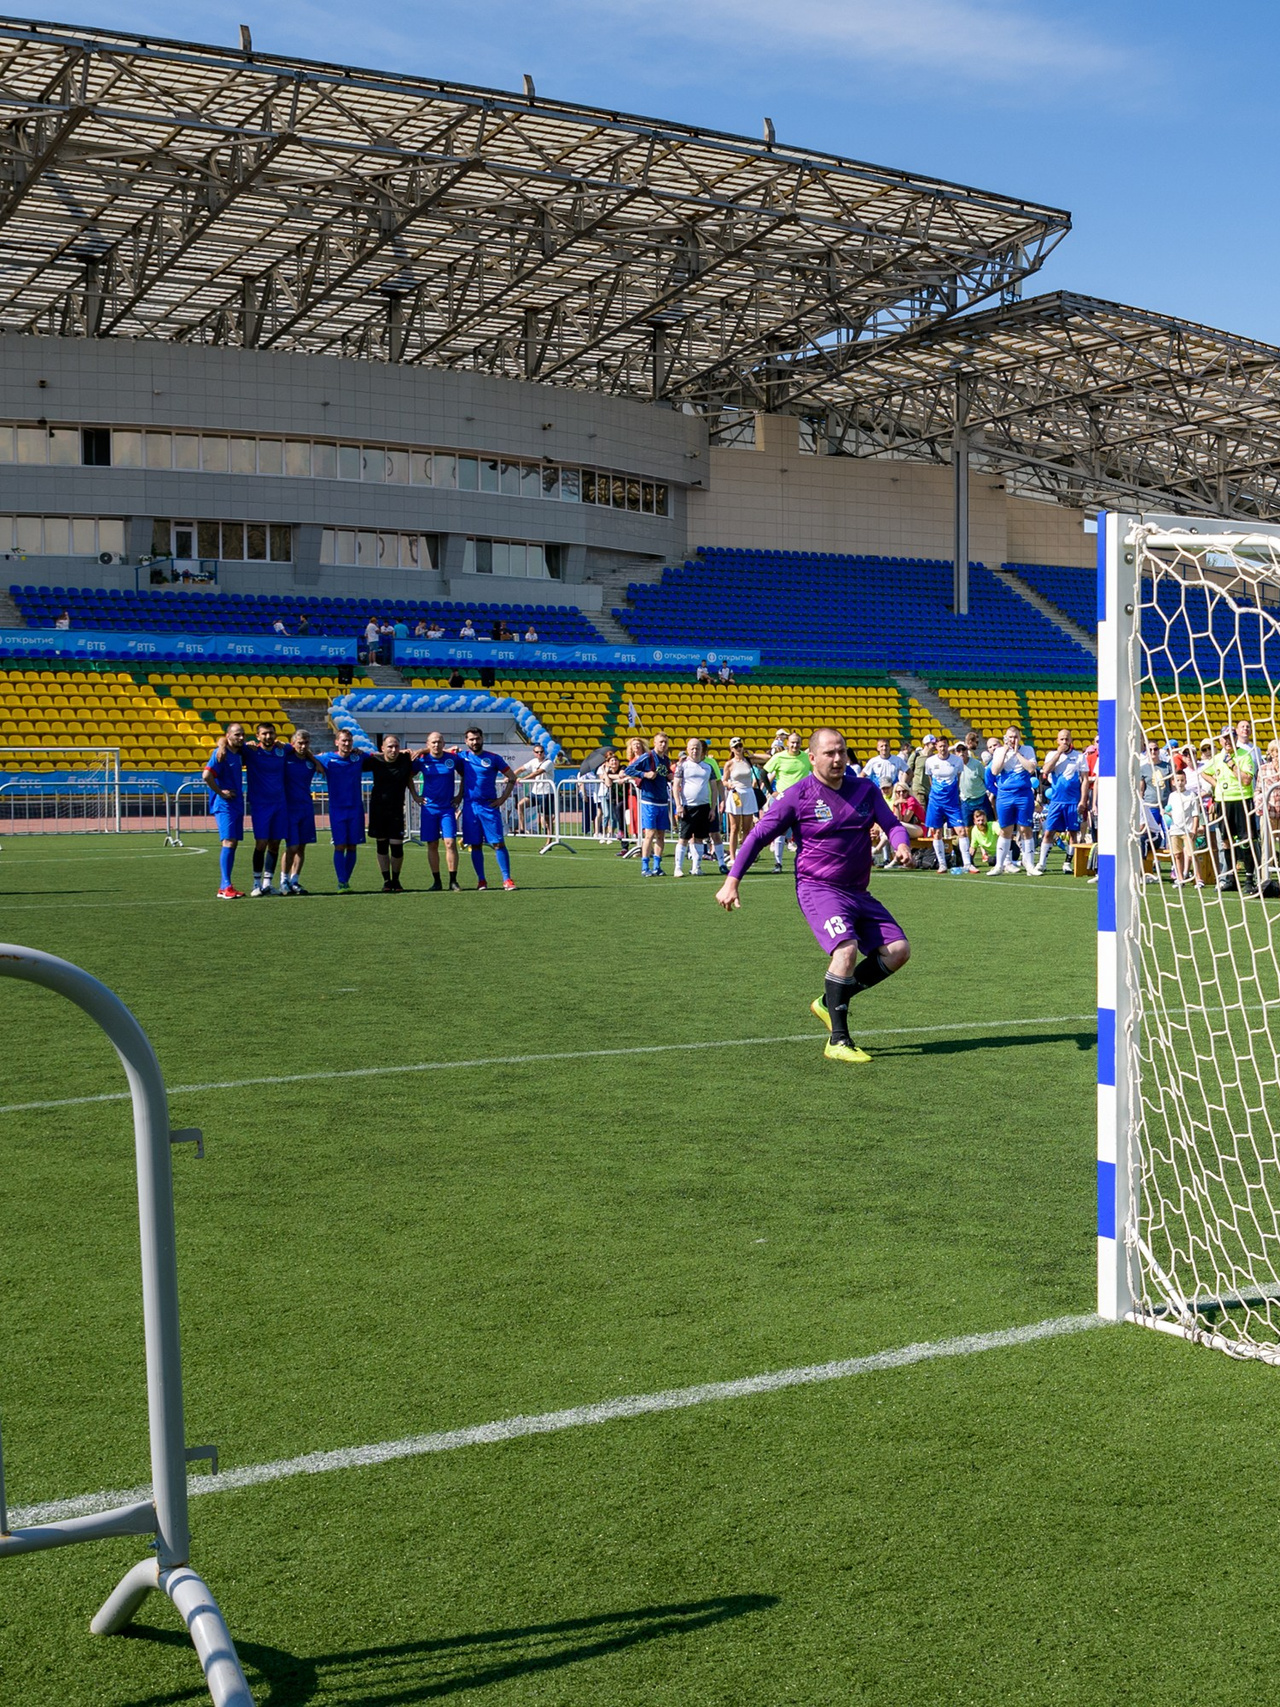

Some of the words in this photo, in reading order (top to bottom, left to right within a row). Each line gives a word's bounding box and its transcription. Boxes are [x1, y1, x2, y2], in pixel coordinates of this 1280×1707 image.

[87, 641, 106, 650] ВТБ
[137, 642, 156, 651] ВТБ
[185, 644, 203, 653] ВТБ
[236, 645, 254, 653] ВТБ
[283, 646, 300, 655] ВТБ
[328, 647, 346, 655] ВТБ
[413, 649, 430, 657] ВТБ
[456, 650, 473, 659] ВТБ
[498, 651, 515, 660] ВТБ
[541, 652, 558, 660] ВТБ
[581, 653, 597, 661] ВТБ
[621, 654, 636, 663] ВТБ
[664, 653, 701, 661] открытие
[718, 654, 754, 662] открытие
[823, 915, 847, 938] 13
